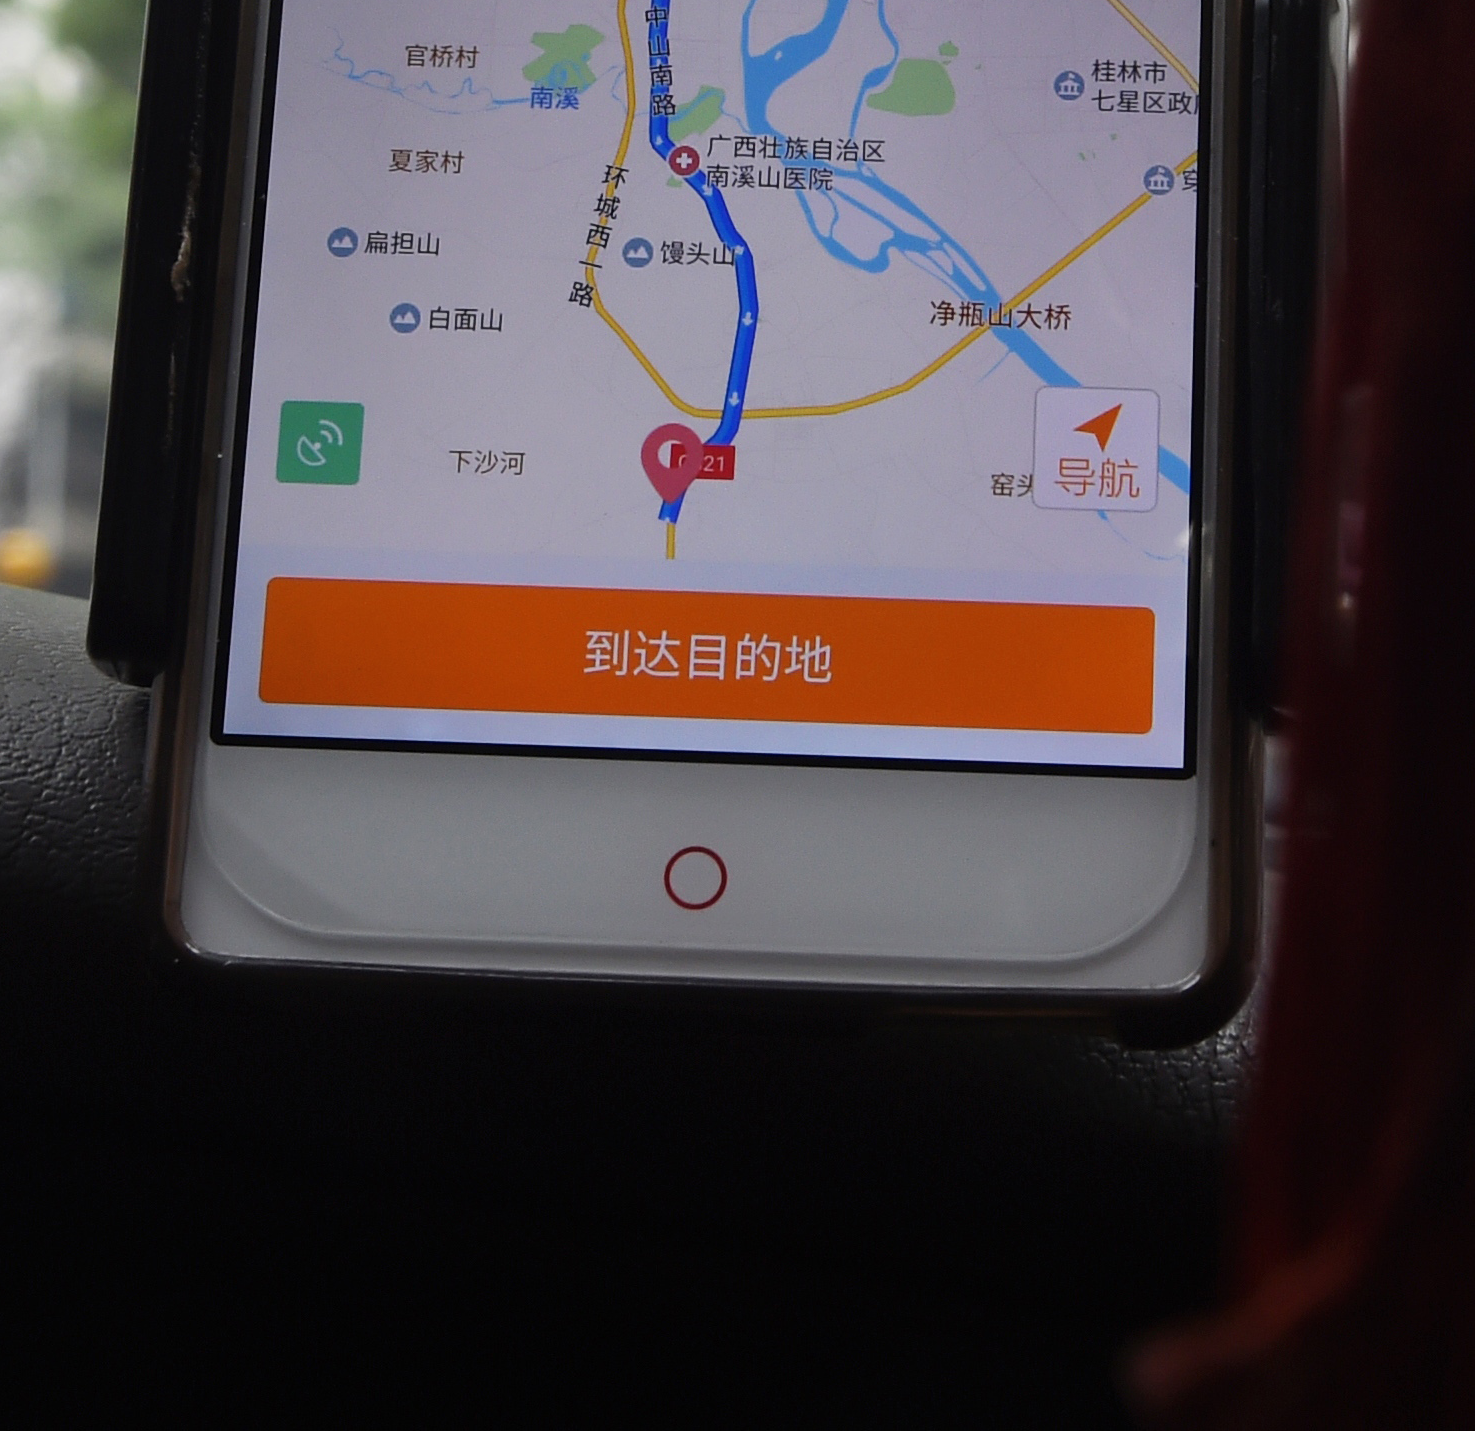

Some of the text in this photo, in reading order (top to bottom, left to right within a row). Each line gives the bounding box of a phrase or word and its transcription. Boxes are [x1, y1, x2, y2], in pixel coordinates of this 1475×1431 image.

[405, 44, 480, 69] 官桥村
[645, 6, 677, 117] 中山南路
[1091, 59, 1167, 84] 桂林市
[530, 87, 580, 110] 南溪
[1091, 89, 1199, 115] 七星区政
[389, 149, 465, 174] 夏家村
[707, 135, 886, 163] 广西壮族自治区
[706, 164, 834, 191] 南溪山医院
[363, 231, 440, 256] 扁担山
[568, 164, 630, 308] 环城西一路
[659, 241, 735, 266] 馒头山
[429, 306, 503, 332] 白面山
[929, 300, 1072, 331] 净瓶山大桥
[449, 450, 526, 476] 下沙河
[1054, 457, 1140, 498] 导航
[583, 630, 832, 683] 到达目的地
